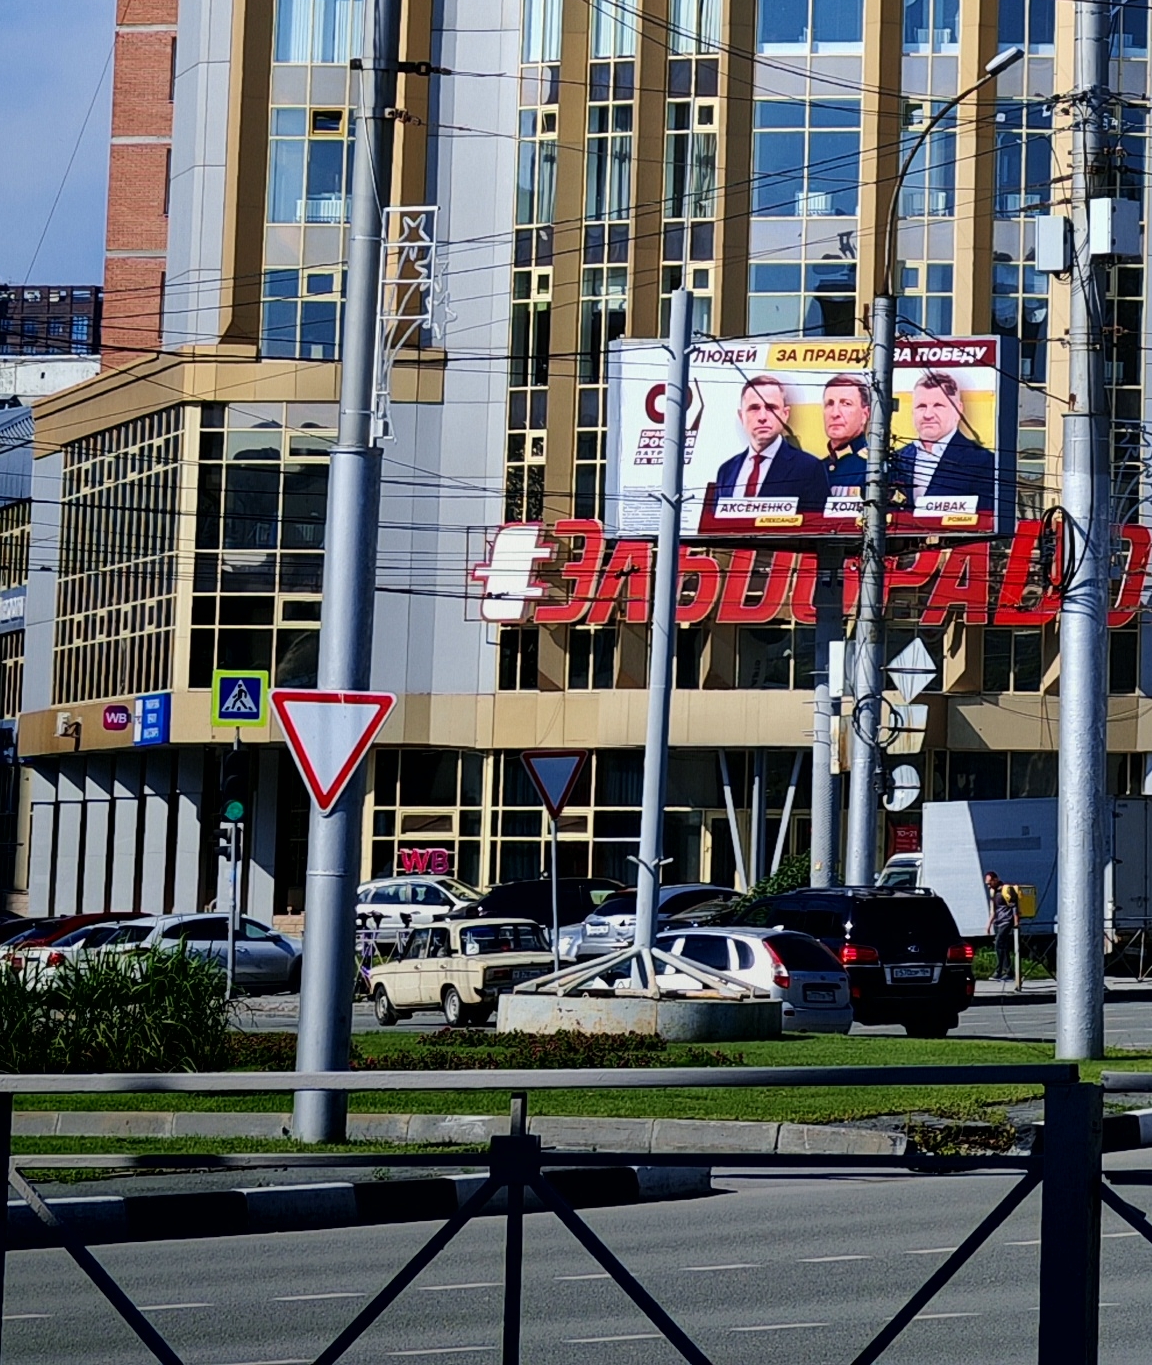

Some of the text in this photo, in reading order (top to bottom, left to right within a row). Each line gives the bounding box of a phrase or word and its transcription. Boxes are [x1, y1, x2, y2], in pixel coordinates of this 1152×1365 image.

[693, 346, 757, 365] ЛЮДЕЙ
[776, 349, 798, 362] ЗА
[915, 346, 988, 364] ПОБЕДУ
[925, 501, 967, 512] СИВАК
[105, 712, 127, 724] WB
[400, 847, 449, 875] WB
